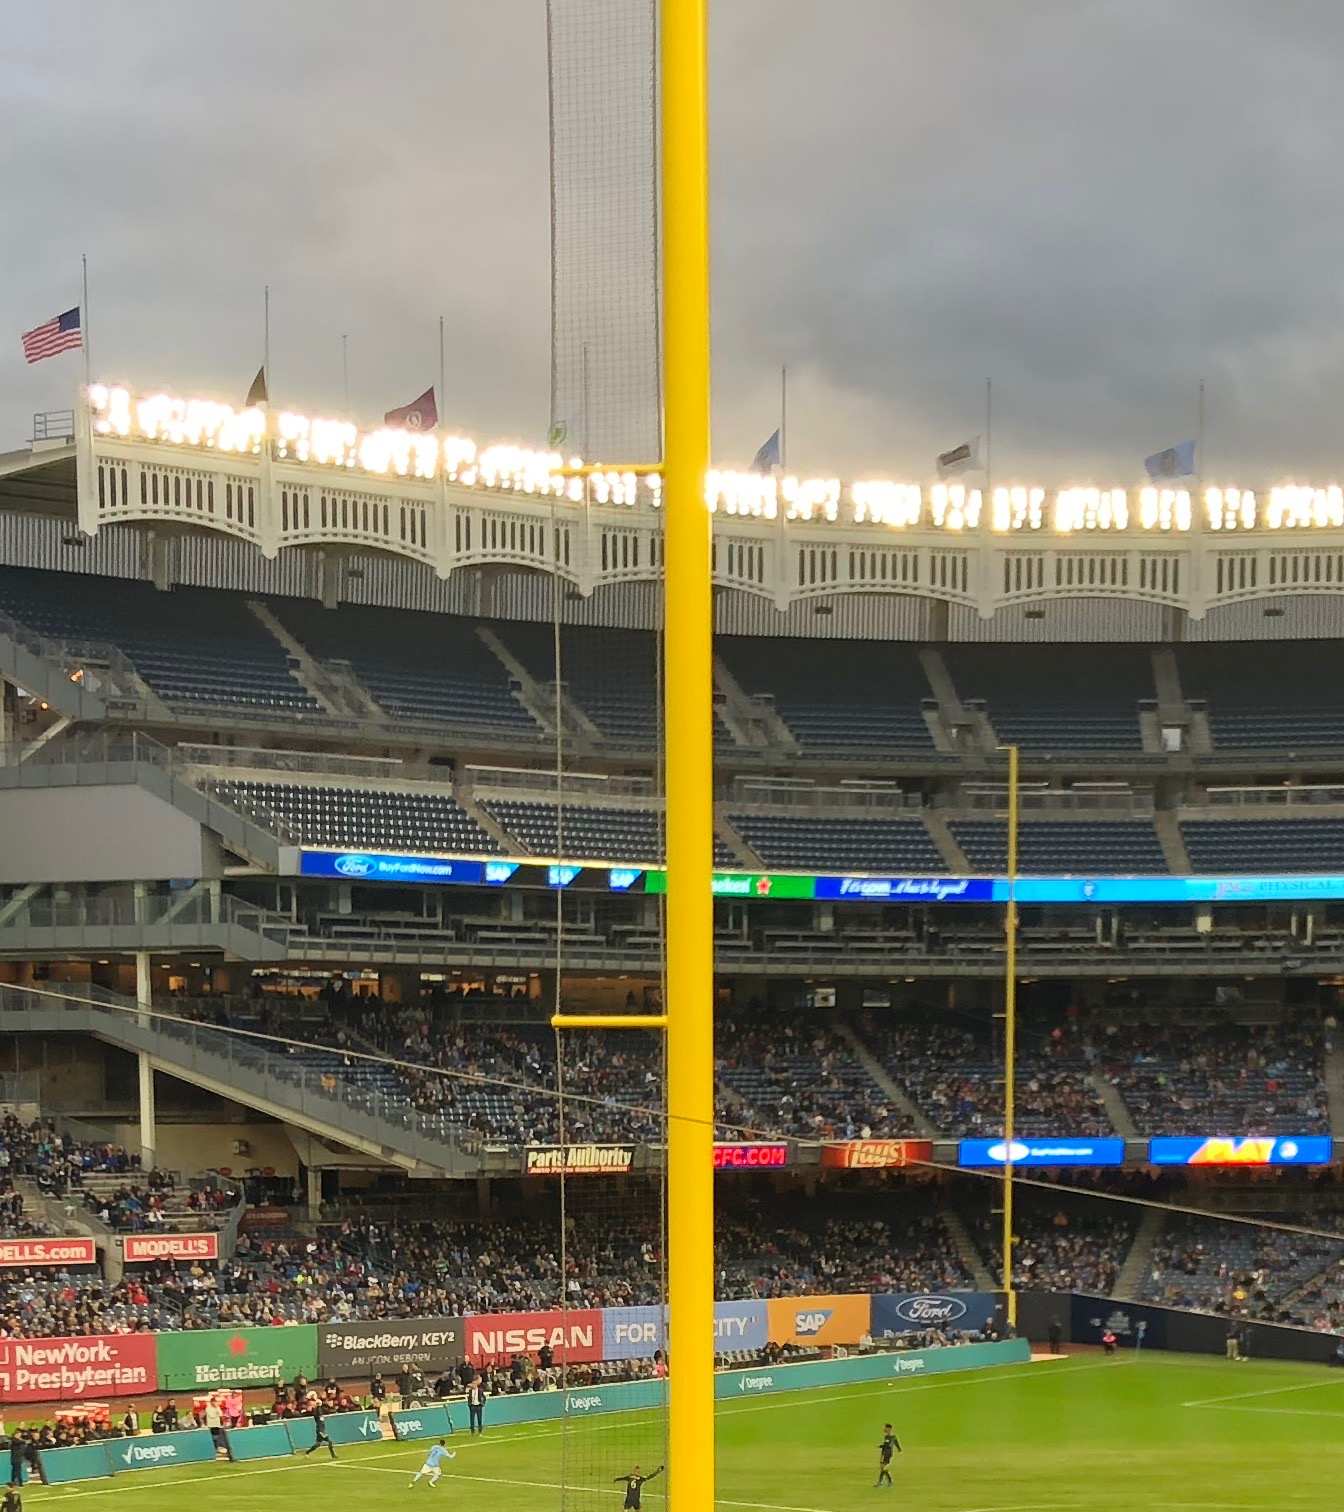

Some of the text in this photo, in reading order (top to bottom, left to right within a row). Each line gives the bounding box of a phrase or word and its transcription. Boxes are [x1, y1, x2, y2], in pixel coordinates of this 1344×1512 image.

[485, 865, 511, 883] SAP
[610, 870, 634, 888] SAP
[527, 1145, 633, 1168] Parts Authority
[713, 1148, 786, 1165] CFC.COM
[133, 1238, 209, 1257] MODELL'S
[908, 1298, 952, 1319] Ford
[795, 1312, 827, 1333] SAP
[472, 1326, 593, 1355] NISSAN
[615, 1322, 657, 1344] FOR
[15, 1364, 147, 1394] Presbyterian
[195, 1362, 281, 1383] Heineken
[746, 1375, 774, 1391] Degree
[570, 1395, 603, 1411] Degree
[134, 1443, 178, 1462] Degree
